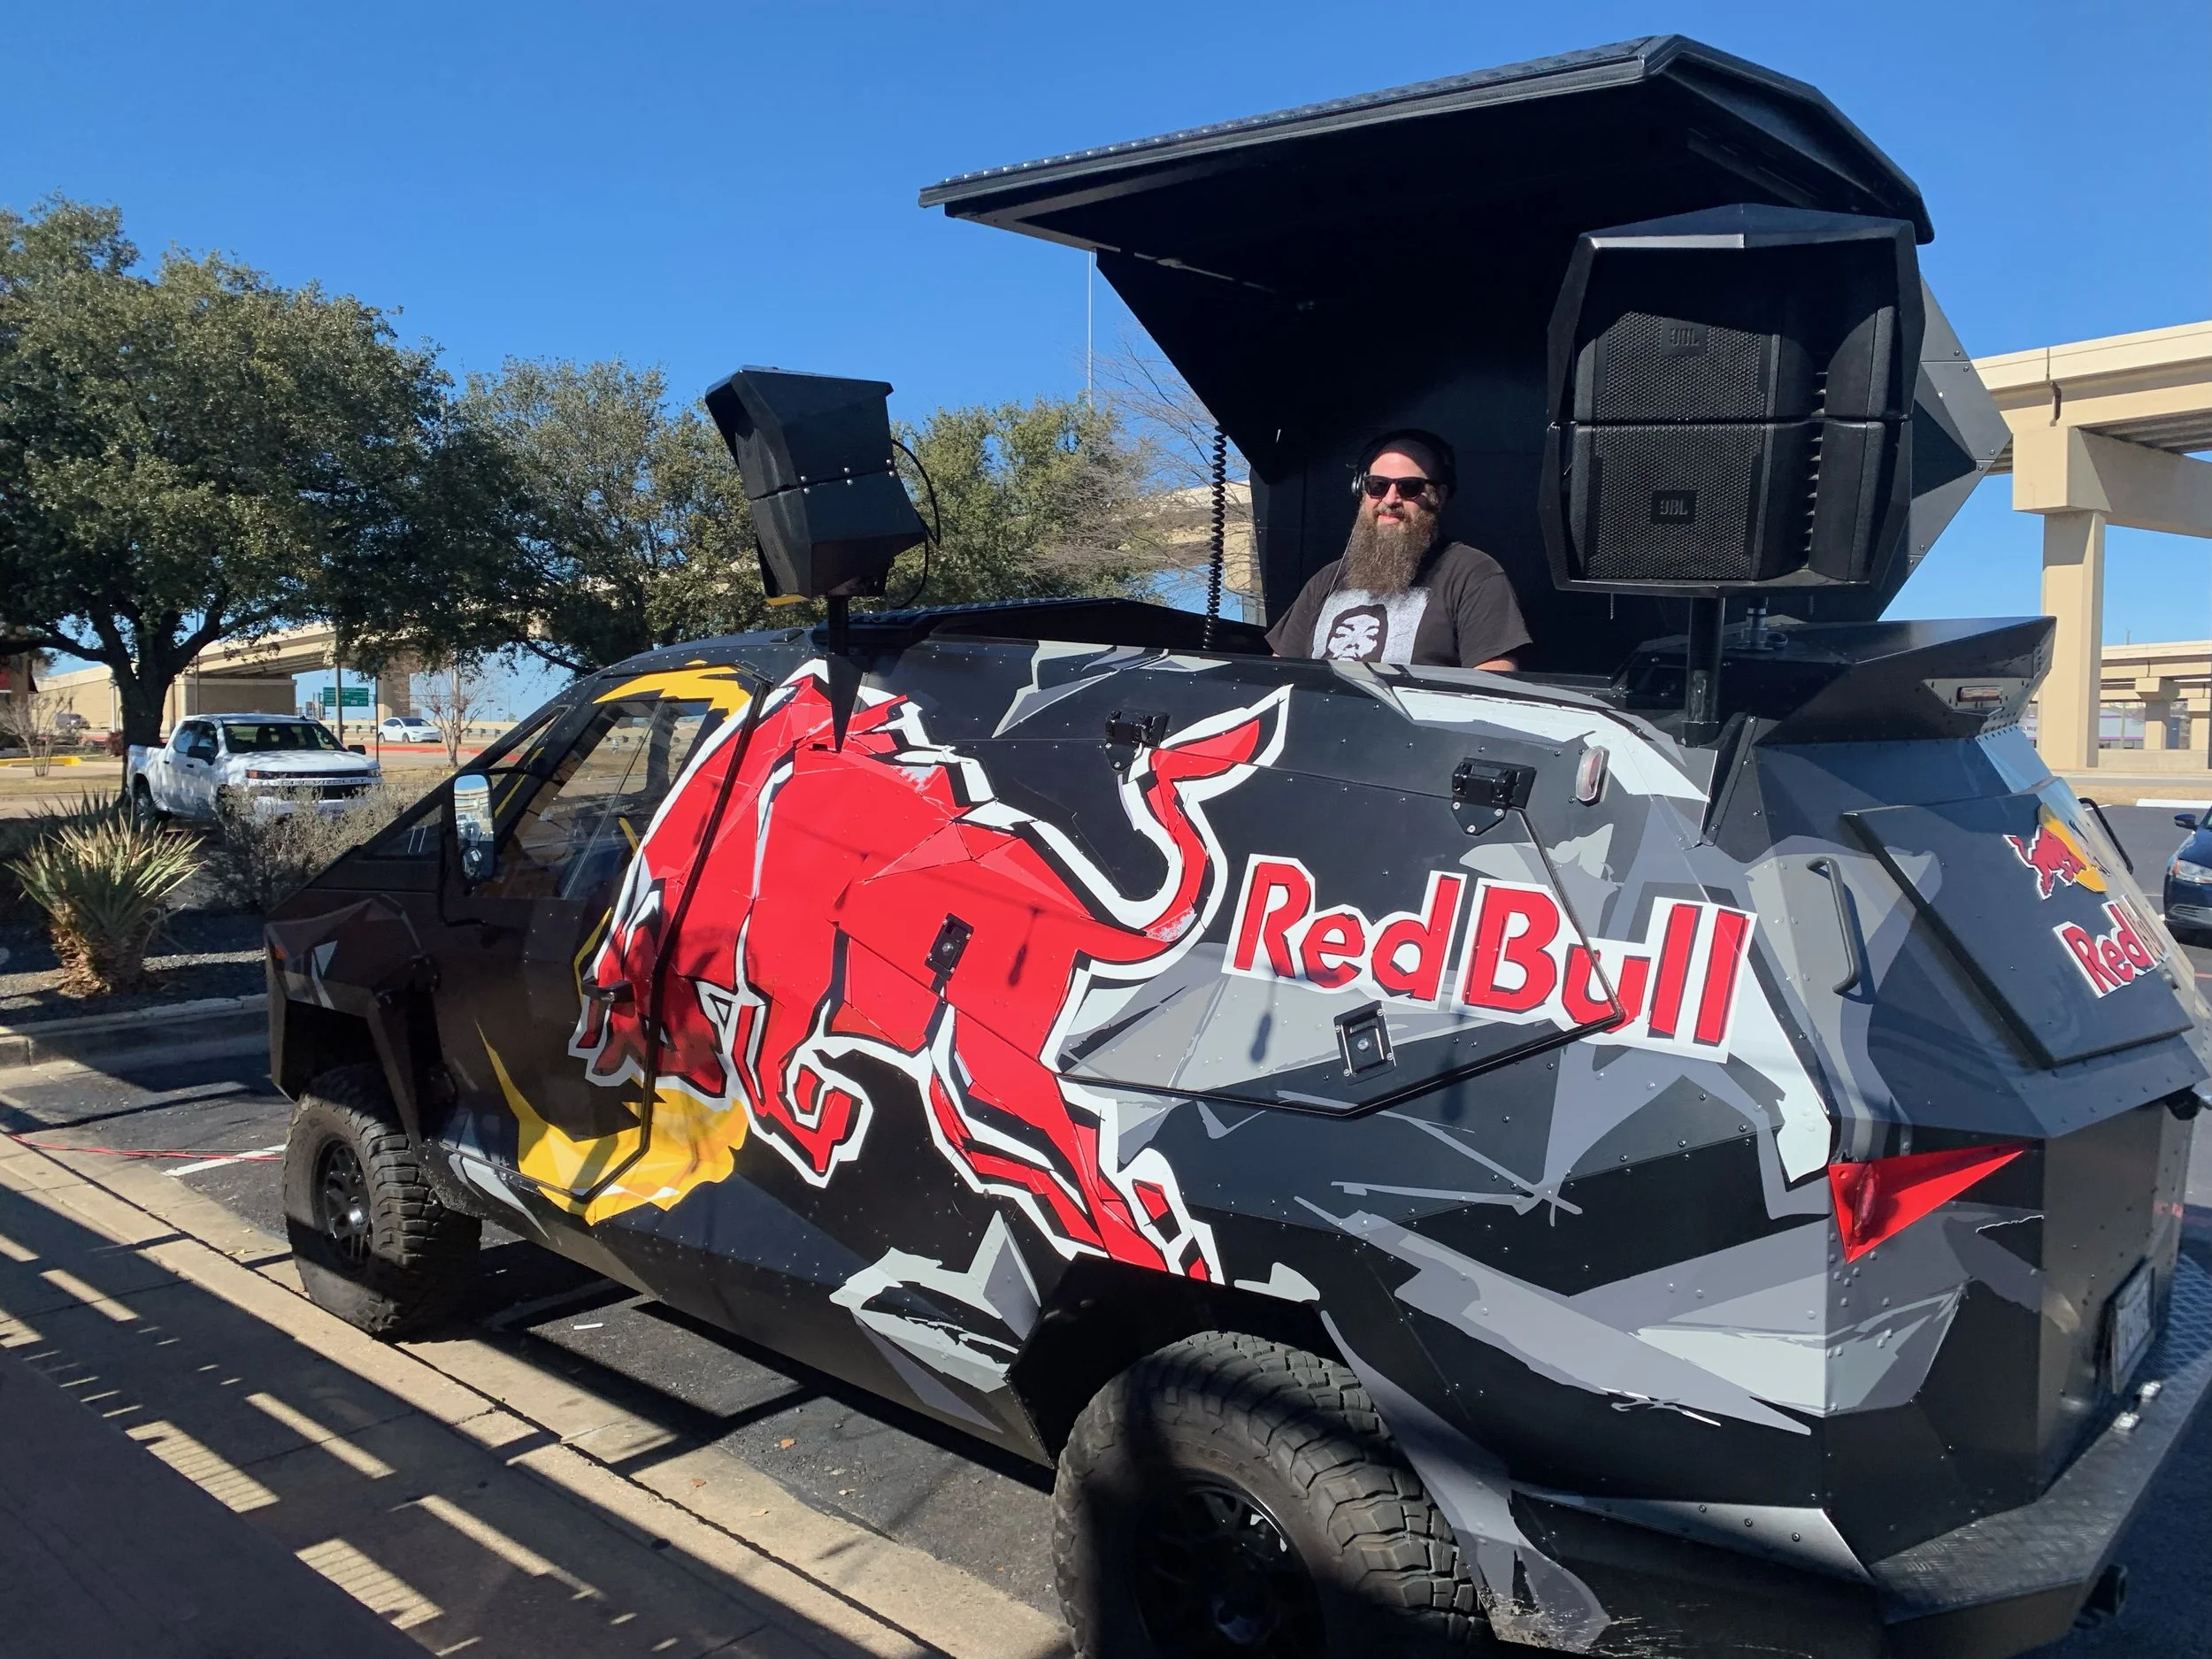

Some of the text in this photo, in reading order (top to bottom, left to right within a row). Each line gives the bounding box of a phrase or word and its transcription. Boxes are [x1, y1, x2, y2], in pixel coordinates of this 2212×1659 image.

[1670, 327, 1700, 347] JBL
[1660, 499, 1688, 515] JBL
[1233, 860, 1751, 1048] Red Bull
[2062, 904, 2155, 994] Red
